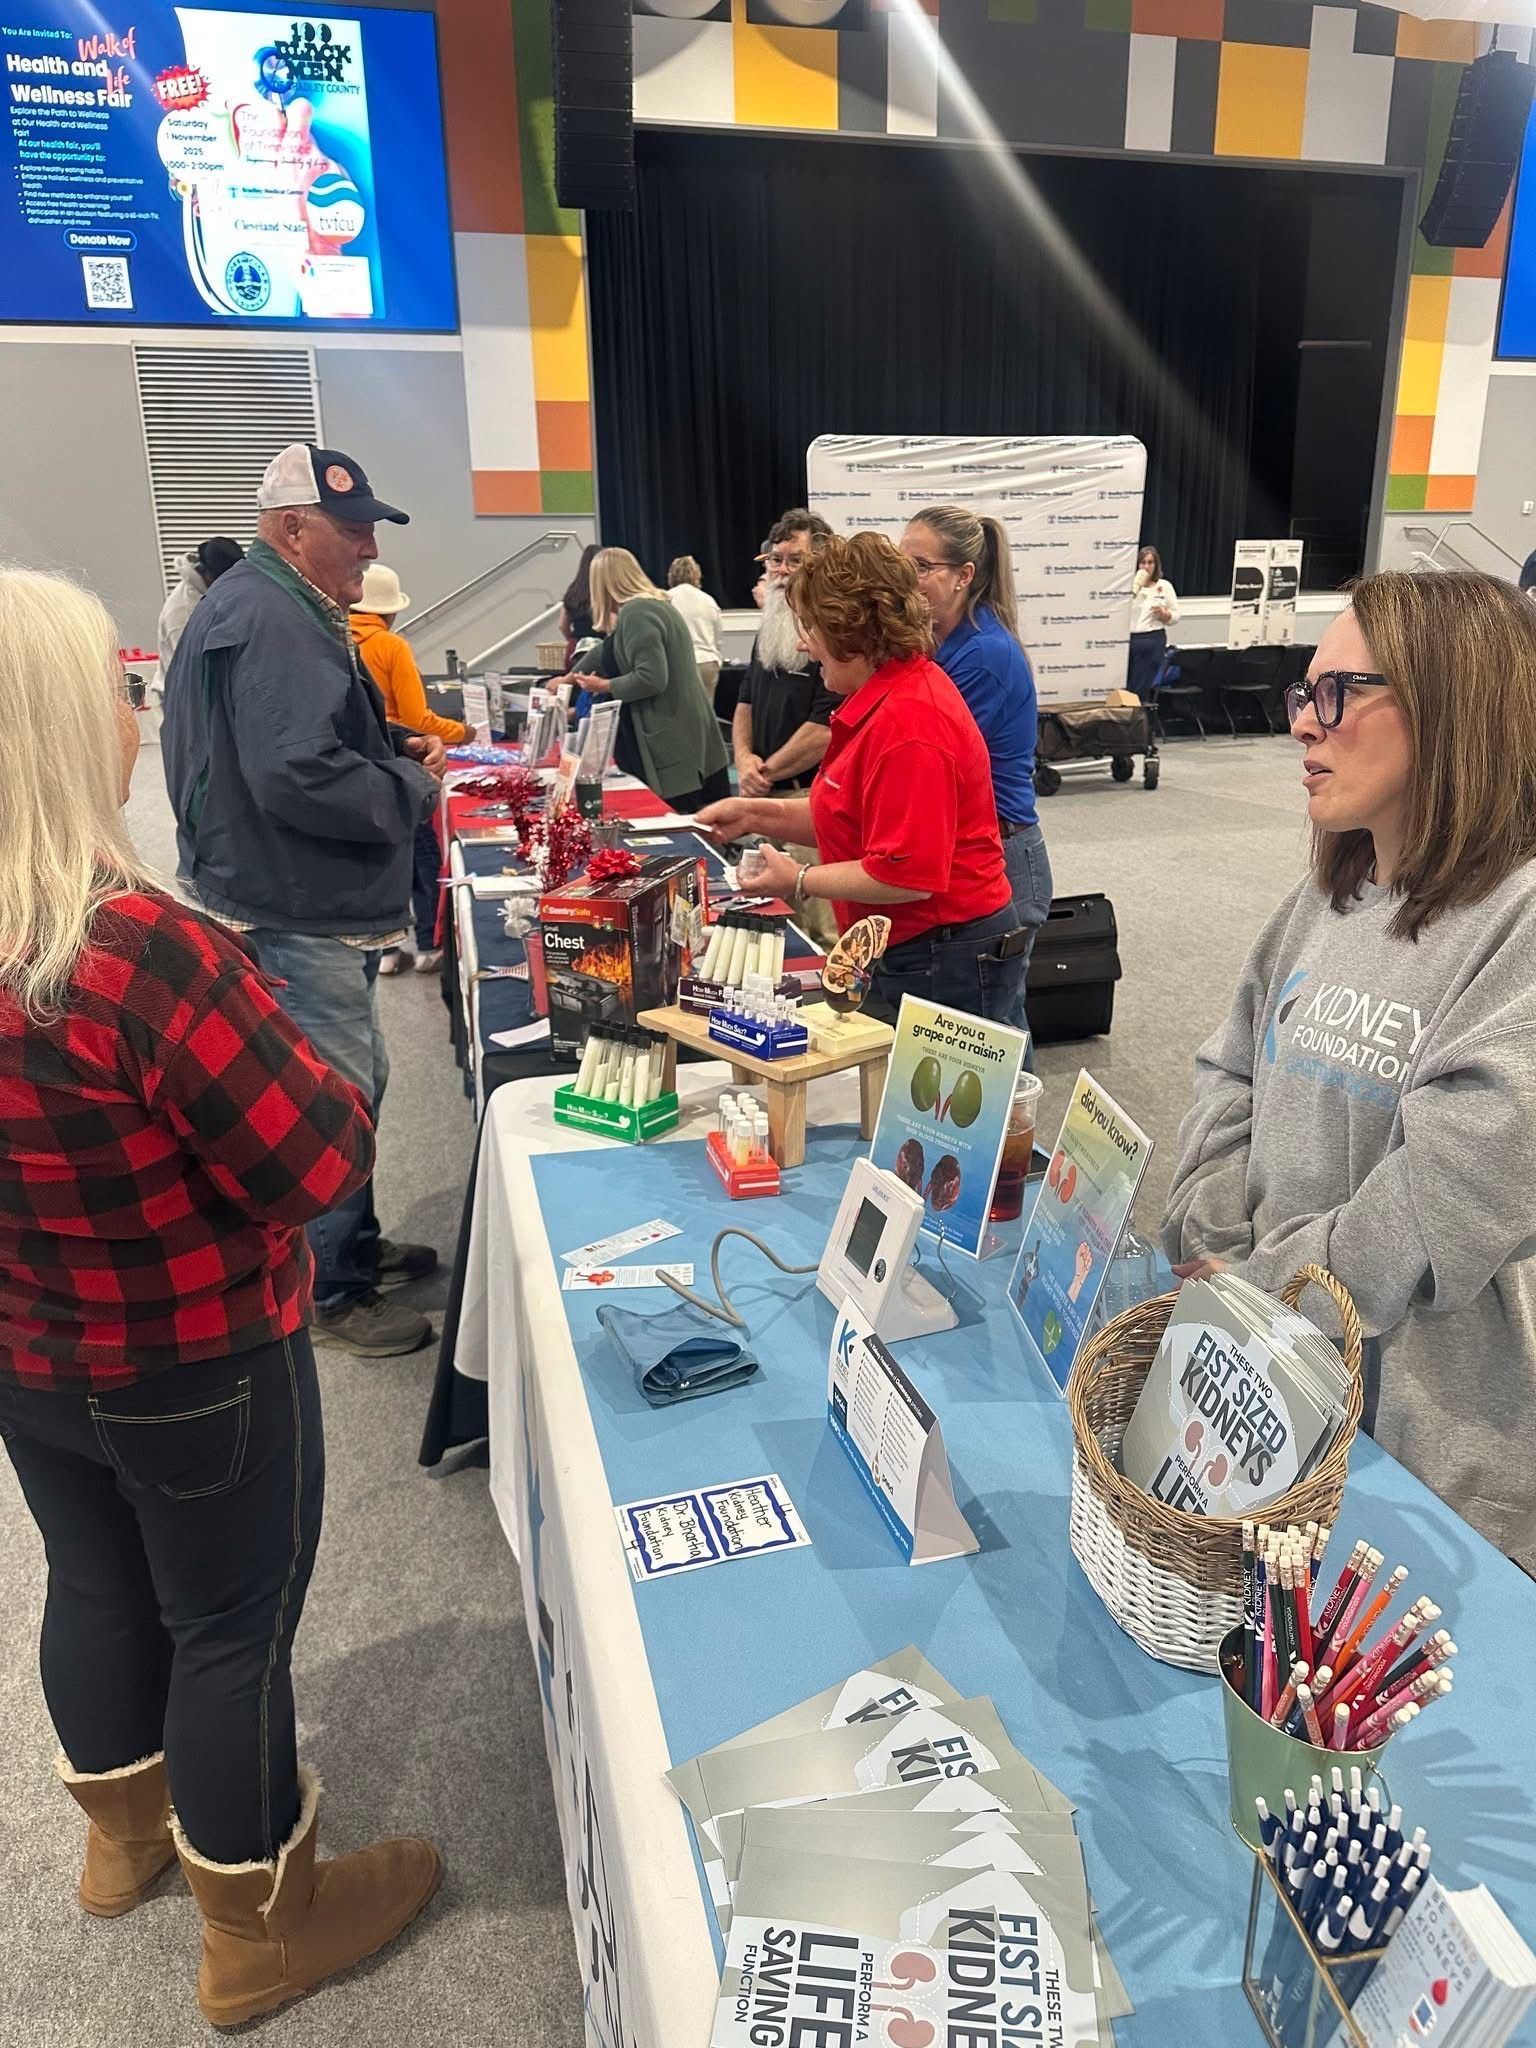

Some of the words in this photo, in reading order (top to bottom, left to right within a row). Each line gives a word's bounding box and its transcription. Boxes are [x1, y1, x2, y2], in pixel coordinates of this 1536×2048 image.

[2, 27, 17, 36] You
[19, 28, 32, 36] Are
[33, 29, 60, 38] Invited
[60, 30, 72, 39] To:
[78, 33, 126, 61] Walk
[122, 26, 136, 59] of
[291, 22, 332, 42] 100
[6, 54, 69, 75] Health
[72, 60, 108, 77] and
[274, 40, 351, 64] BLACK
[107, 66, 130, 95] Life
[286, 60, 344, 82] MEN
[10, 84, 95, 105] Wellness
[97, 88, 132, 108] Fair
[157, 74, 202, 100] FREE!
[327, 84, 360, 95] COUNTY
[10, 106, 36, 116] Explore
[38, 108, 49, 116] the
[78, 110, 109, 119] Wellness
[12, 118, 21, 126] at
[21, 118, 34, 126] Our
[36, 119, 60, 128] Health
[77, 122, 108, 130] Wellness
[168, 118, 208, 130] Saturday
[14, 129, 29, 137] Fair!
[18, 139, 27, 147] At
[41, 140, 65, 149] health
[66, 141, 81, 150] fair,
[172, 133, 216, 142] November
[20, 150, 38, 158] have
[39, 151, 51, 159] the
[53, 152, 94, 162] opportunity
[96, 154, 106, 162] to:
[184, 147, 203, 155] 2025
[20, 164, 41, 172] Explore
[42, 165, 64, 174] healthy
[65, 166, 84, 174] eating
[70, 233, 106, 246] Donate
[108, 234, 130, 246] Now
[234, 220, 279, 232] Cleveland
[283, 223, 309, 233] State
[550, 904, 590, 917] SentrySafe
[544, 933, 585, 950] Chest
[934, 1013, 954, 1030] Are
[955, 1023, 976, 1036] you
[978, 1032, 985, 1040] a
[1304, 982, 1429, 1055] KIDNEY
[913, 1024, 944, 1042] grape
[945, 1036, 958, 1046] or
[959, 1040, 966, 1049] a
[968, 1043, 1005, 1062] raisin?
[922, 1046, 936, 1056] THESE
[938, 1051, 948, 1059] ARE
[949, 1055, 962, 1065] YOUR
[963, 1061, 985, 1073] KIDNEYS
[936, 1131, 957, 1144] KIDNEYS
[1080, 1089, 1096, 1114] did
[1091, 1106, 1109, 1130] you
[1107, 1116, 1138, 1161] know?
[879, 1356, 896, 1377] Foundation
[894, 1378, 914, 1403] Chattanooga
[1228, 1344, 1256, 1378] THESE
[1255, 1376, 1273, 1399] TWO
[1194, 1331, 1238, 1388] FIST
[1232, 1379, 1288, 1454] SIZED
[1179, 1357, 1274, 1487] KIDNEYS
[1175, 1454, 1206, 1500] PERFORM
[1202, 1497, 1209, 1507] A
[673, 1500, 688, 1518] Dr.
[729, 1491, 749, 1520] Kidney
[745, 1488, 772, 1528] Heather
[639, 1511, 665, 1560] Foundation
[656, 1506, 674, 1537] Kidney
[716, 1500, 744, 1549] Foundation
[679, 1517, 704, 1558] Bhartia
[1243, 1568, 1251, 1606] KIDNEY
[1255, 1579, 1263, 1617] KIDNEY
[1324, 1584, 1344, 1617] KIDNEY
[1287, 1607, 1295, 1645] CHATTANOOGA
[1341, 1596, 1360, 1630] FOUNDATION
[1372, 1633, 1395, 1660] KIDNEY
[1366, 1659, 1386, 1691] CHATTANOOGA
[878, 1687, 919, 1716] FI
[932, 1736, 979, 1778] FIS
[1432, 1891, 1448, 1915] BE
[1424, 1900, 1437, 1923] TO
[1441, 1930, 1472, 1978] YOUR
[999, 1914, 1040, 1995] FIST
[1415, 1916, 1464, 1993] KIDNEYS
[735, 1945, 757, 2022] FUNCTION
[750, 1927, 796, 2046] SAVING
[789, 1932, 859, 2048] LIFE
[859, 1953, 873, 2026] PERFORM
[948, 1909, 996, 2048] KIDNE
[1045, 1969, 1062, 2021] THESE
[856, 2030, 868, 2040] A
[1049, 2026, 1063, 2048] TW
